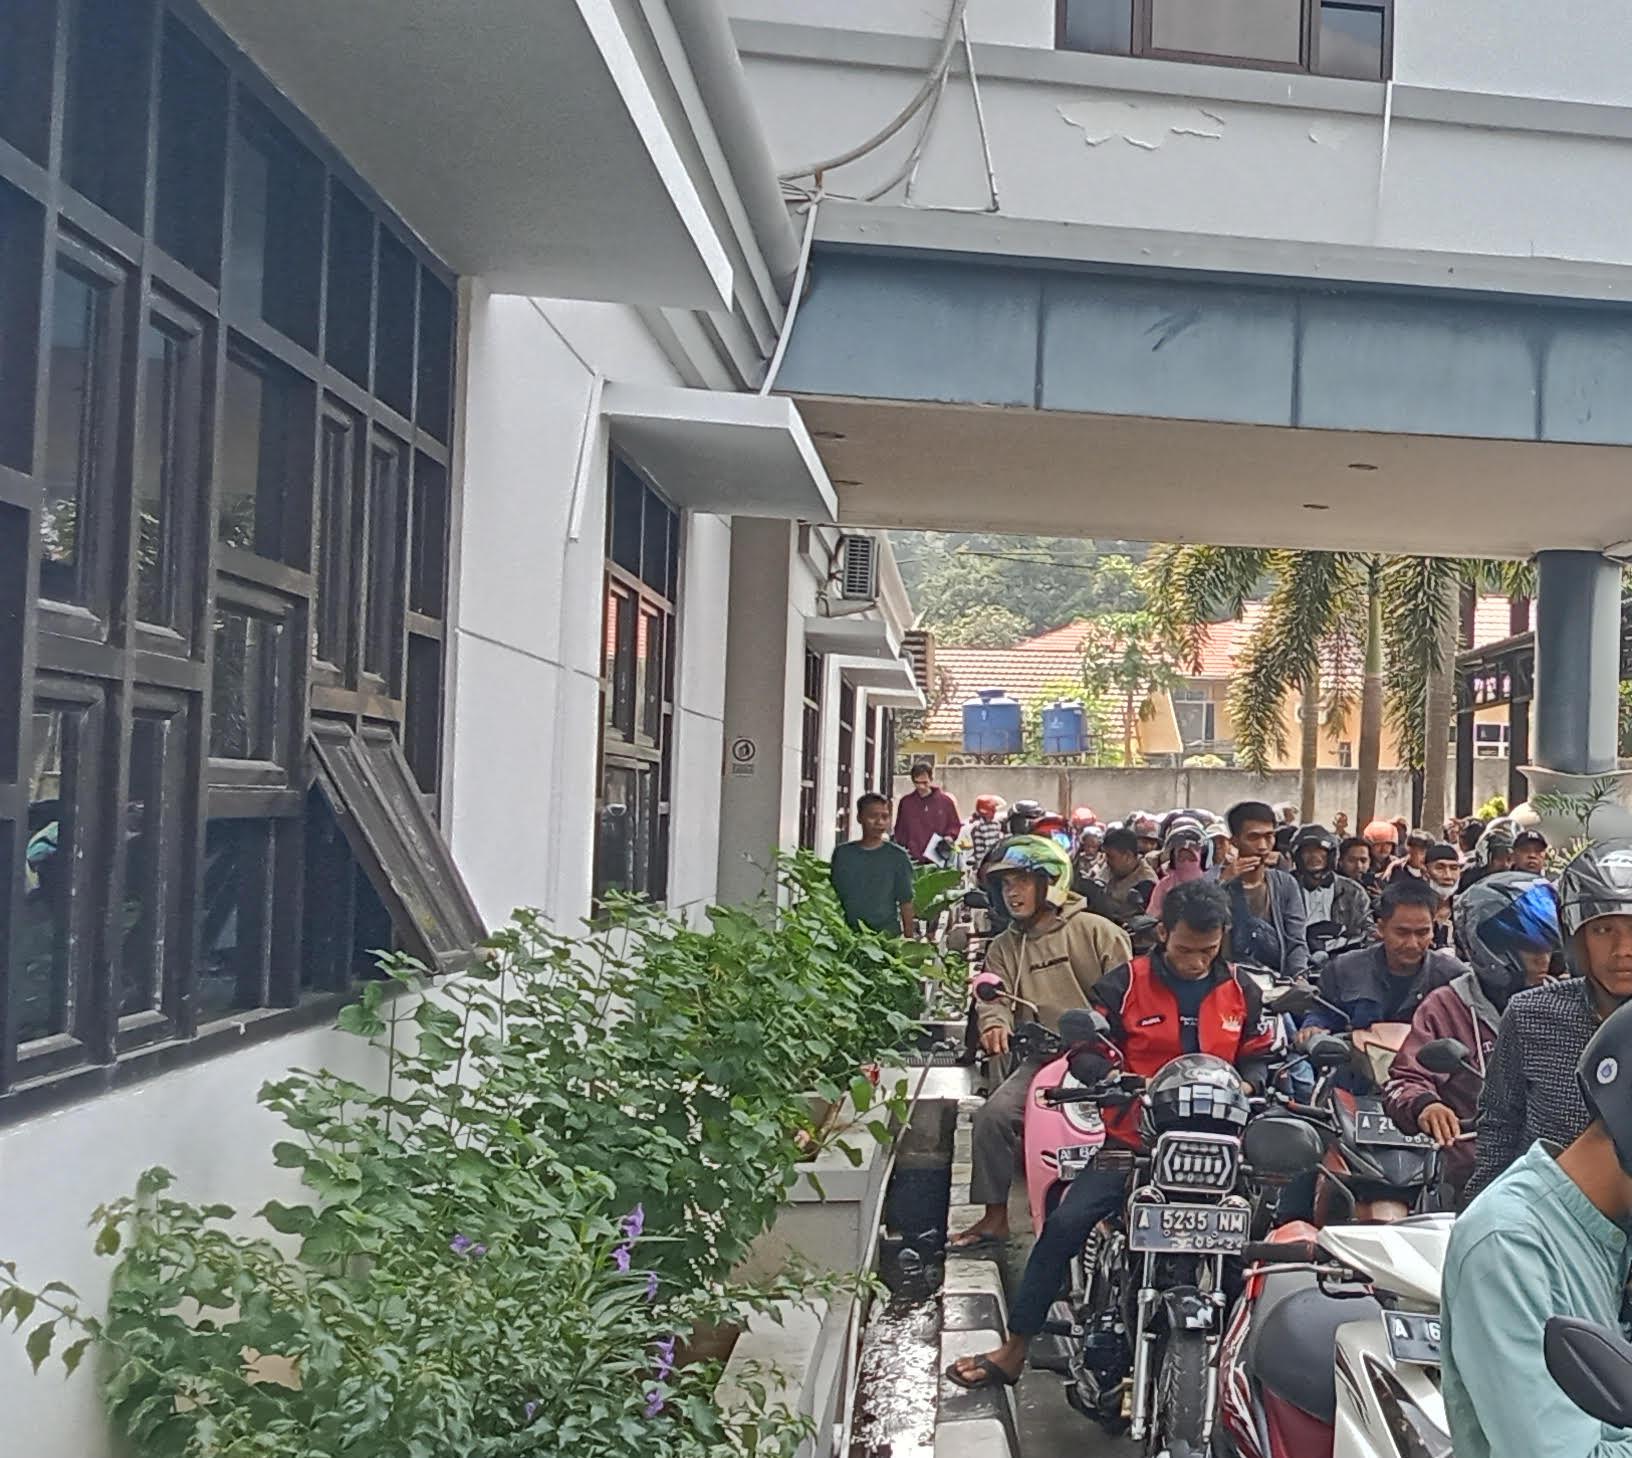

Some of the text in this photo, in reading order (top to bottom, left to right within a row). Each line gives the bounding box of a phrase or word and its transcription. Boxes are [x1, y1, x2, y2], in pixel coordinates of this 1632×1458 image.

[1361, 1115, 1371, 1129] A
[1138, 1207, 1243, 1232] A 5235 NM
[1395, 1317, 1410, 1339] A
